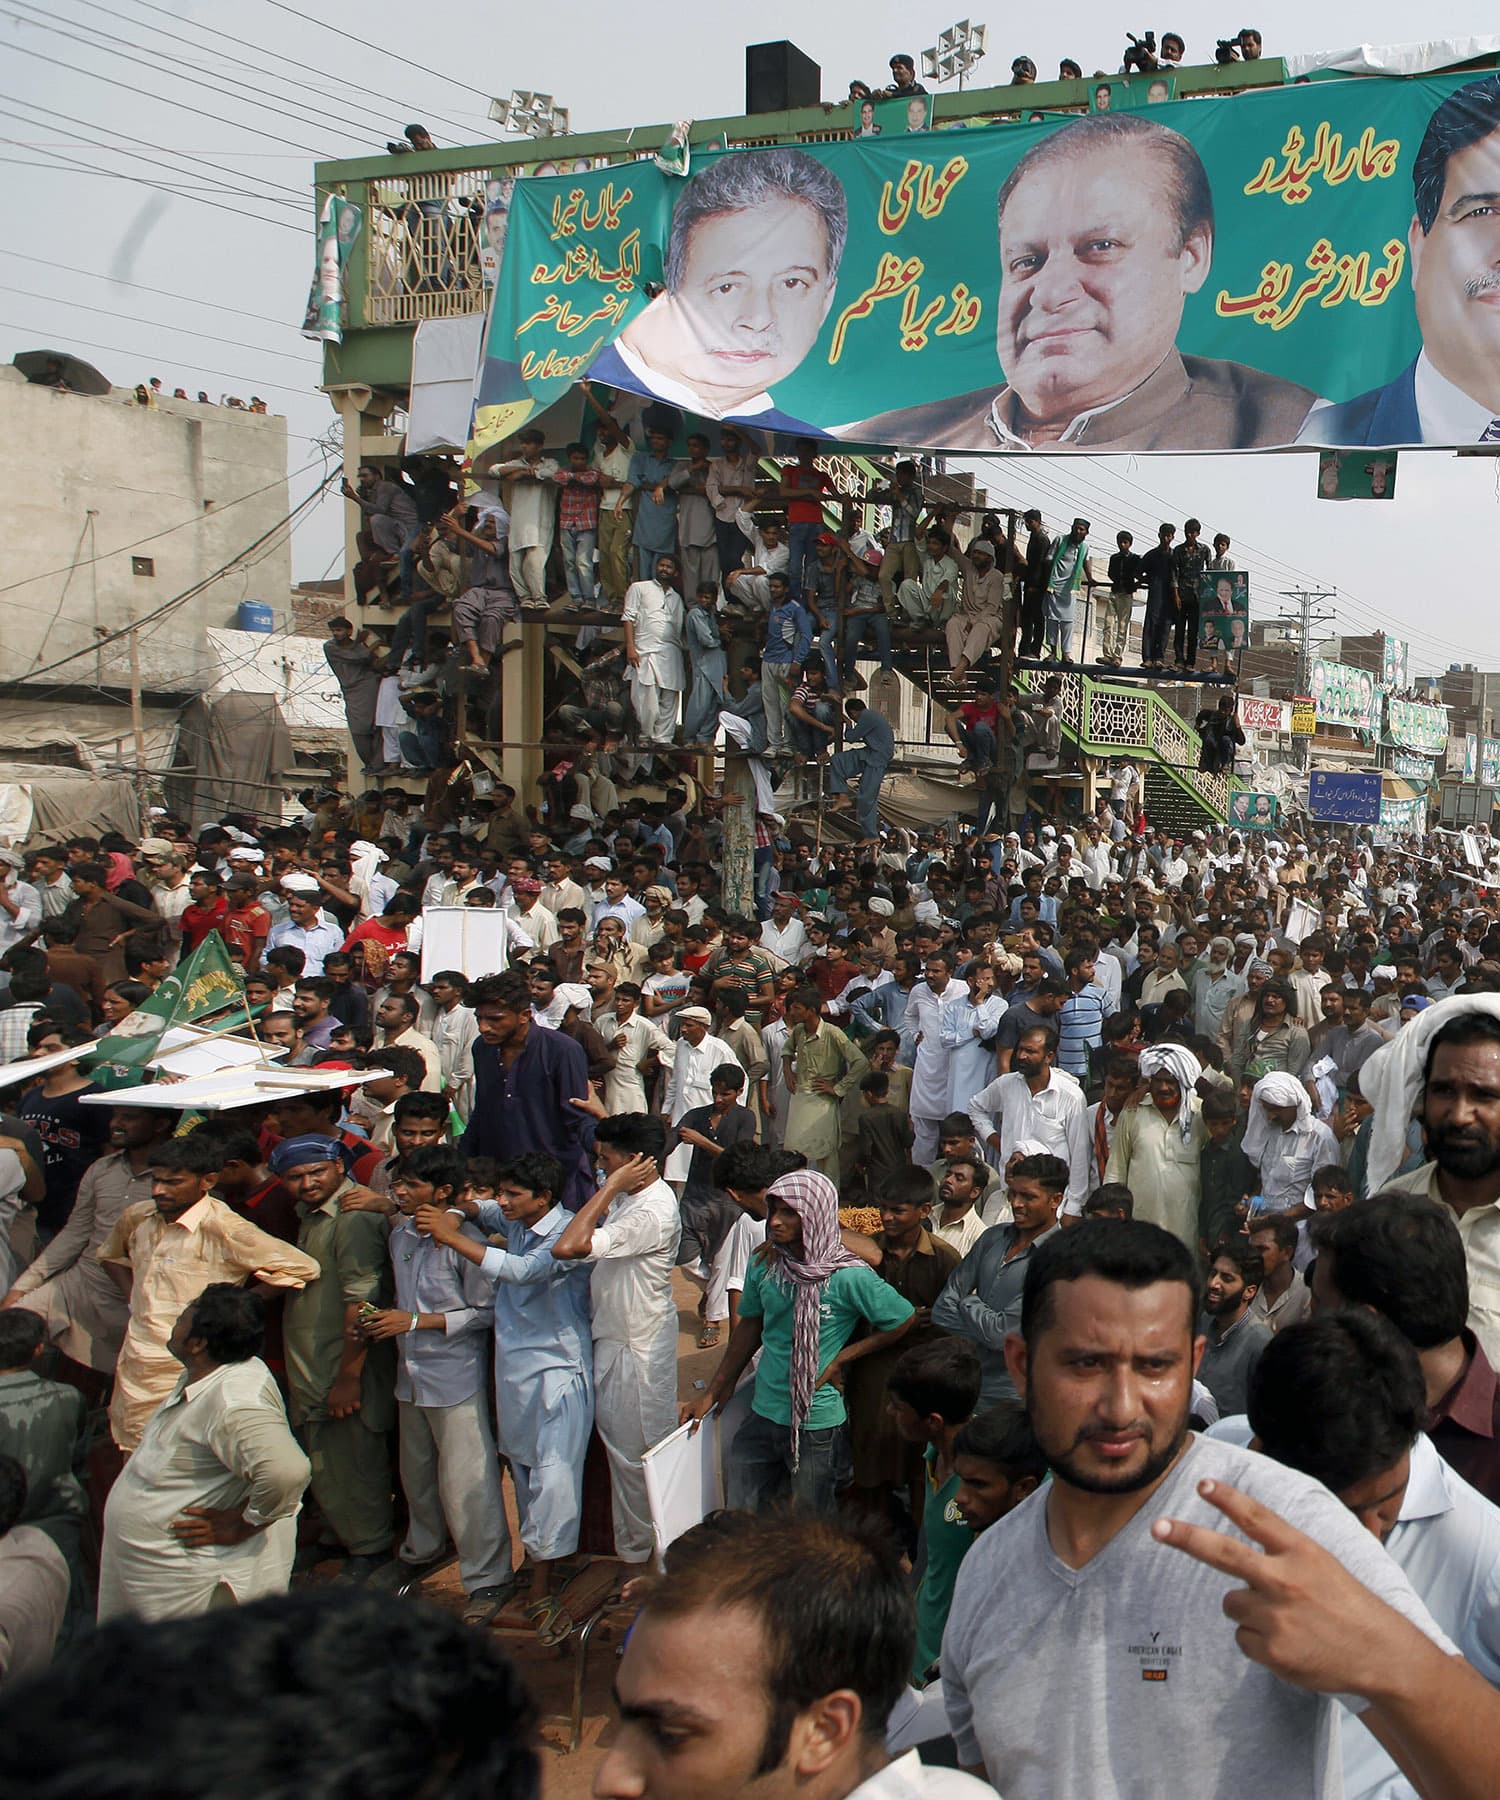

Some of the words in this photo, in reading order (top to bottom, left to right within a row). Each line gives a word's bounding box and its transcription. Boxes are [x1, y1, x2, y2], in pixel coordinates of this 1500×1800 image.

[1243, 121, 1331, 205] لیڈر
[1323, 127, 1400, 185] ہمارا
[550, 188, 584, 241] تیرا
[581, 182, 633, 230] میاں
[878, 155, 968, 235] عوامی
[530, 244, 598, 285] اشارہ
[598, 227, 641, 291] ایک
[1215, 238, 1337, 331] شریف
[1320, 238, 1406, 308] نواز
[515, 294, 583, 341] حاضر
[567, 291, 629, 337] اضر
[520, 349, 572, 381] ہمارا
